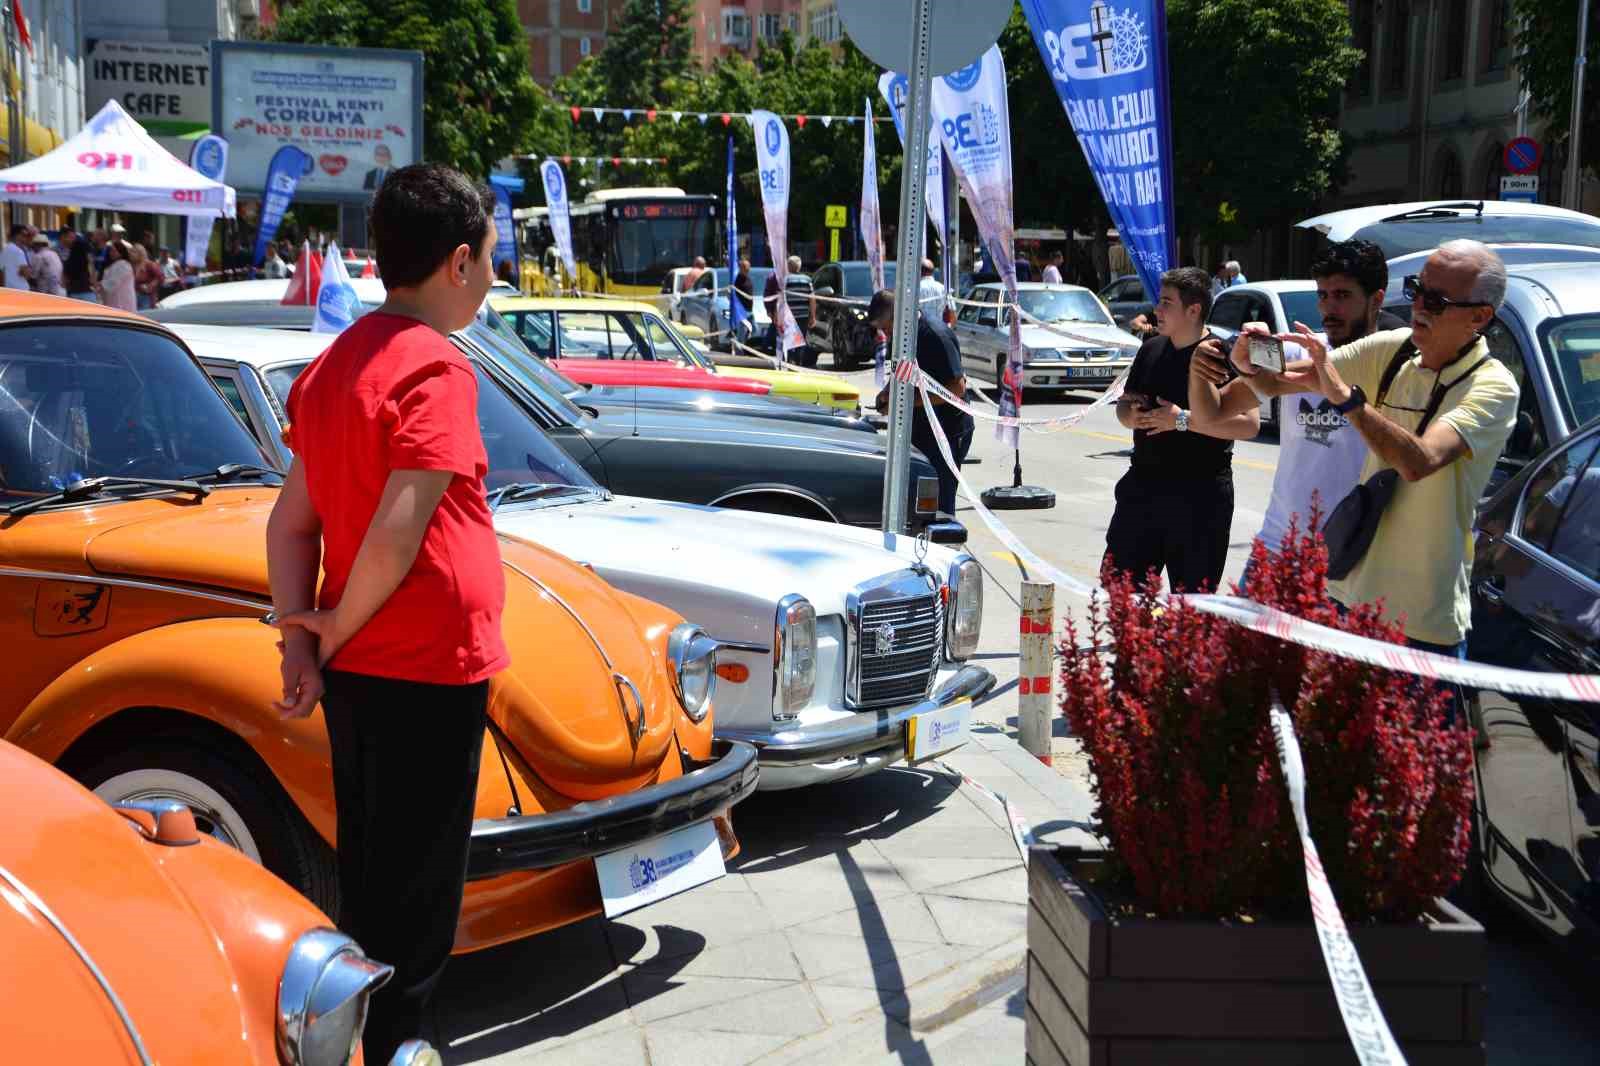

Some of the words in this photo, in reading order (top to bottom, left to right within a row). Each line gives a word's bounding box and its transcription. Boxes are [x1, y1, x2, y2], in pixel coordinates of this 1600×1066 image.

[94, 60, 208, 86] INTERNET
[123, 92, 181, 115] CAFE
[1296, 409, 1350, 426] adidas
[639, 857, 657, 886] 38
